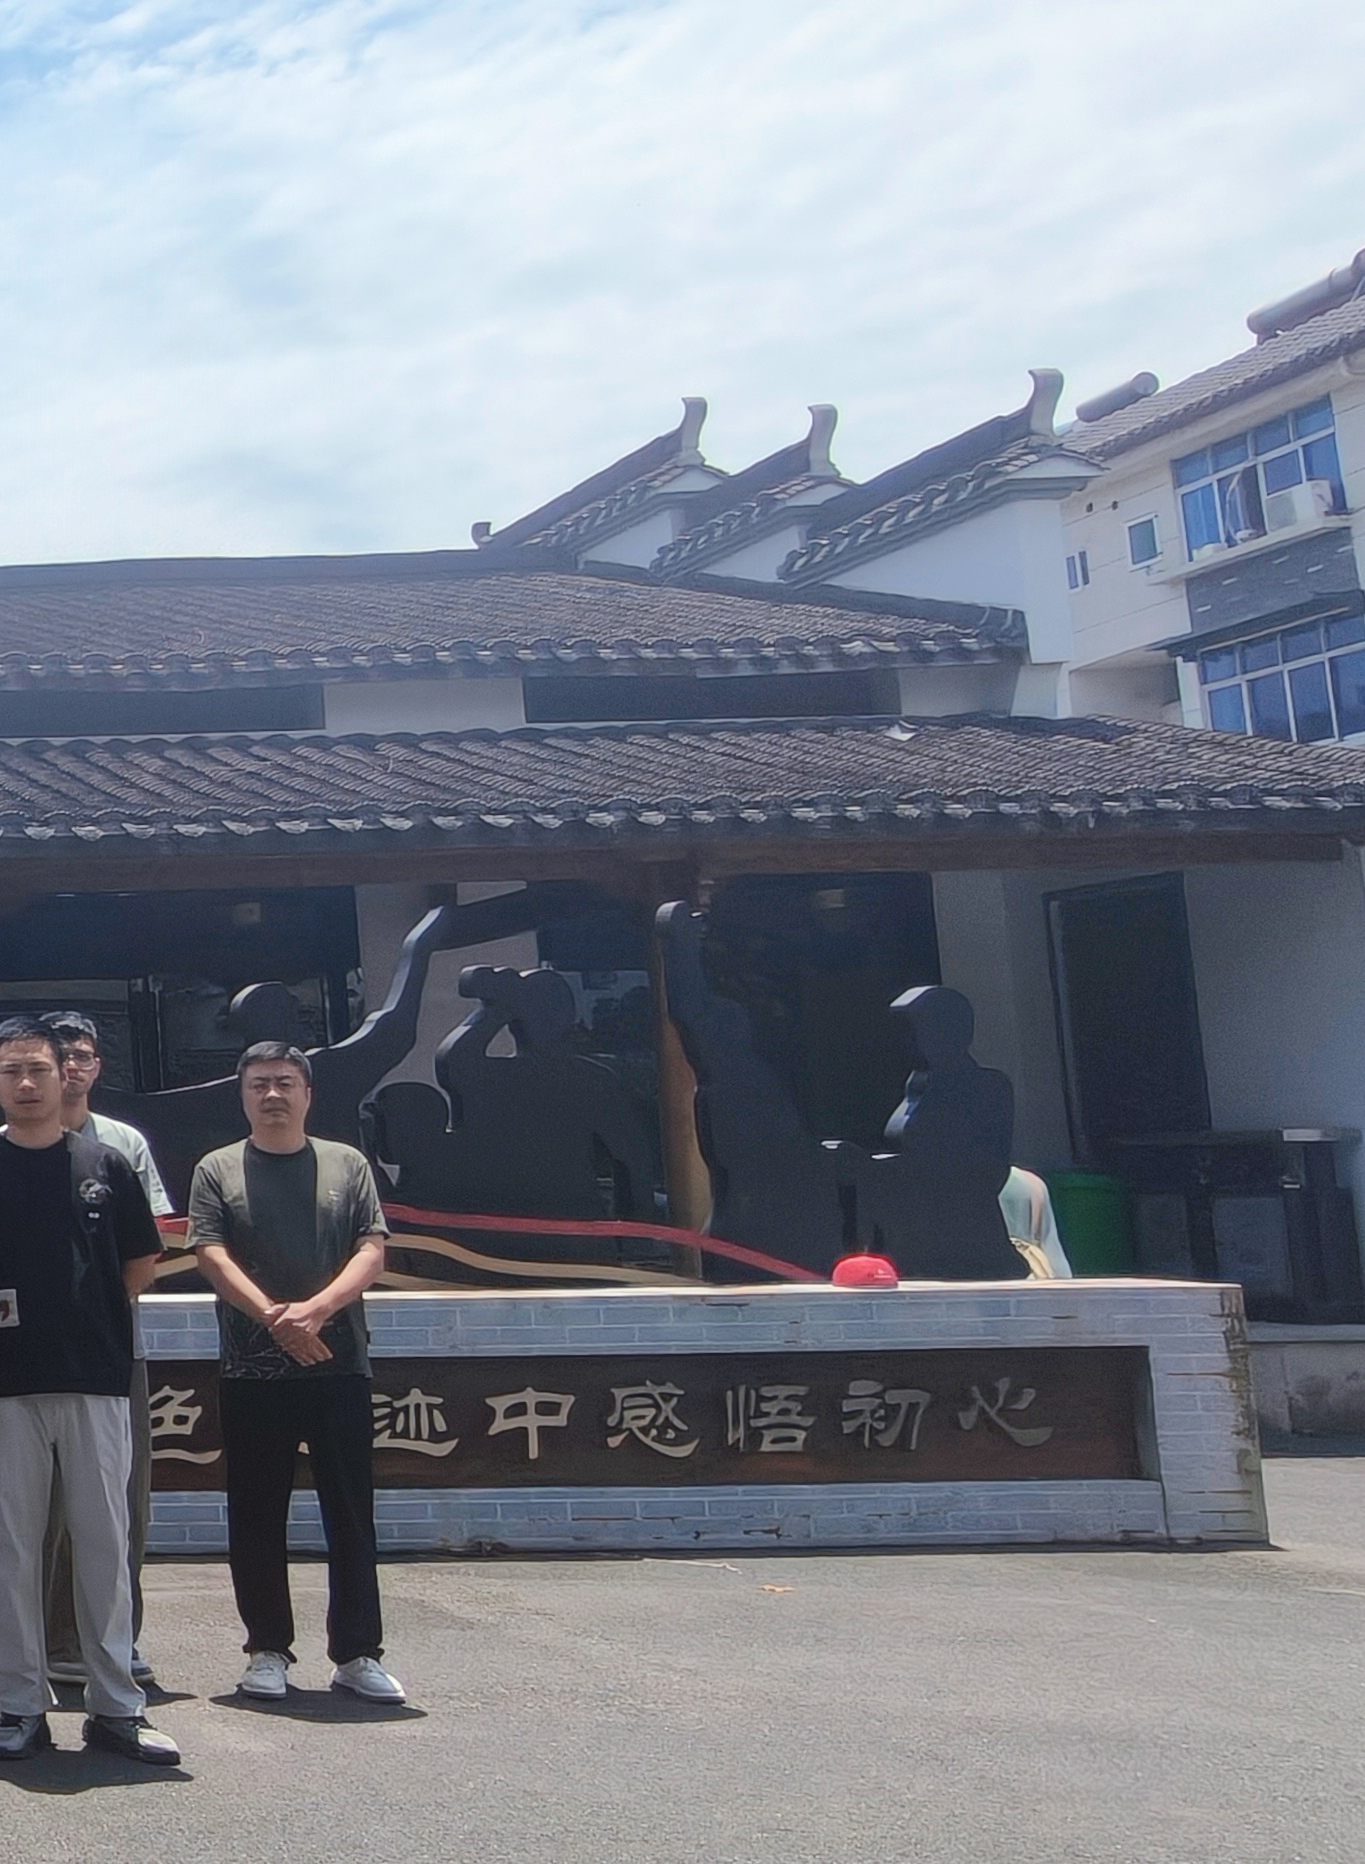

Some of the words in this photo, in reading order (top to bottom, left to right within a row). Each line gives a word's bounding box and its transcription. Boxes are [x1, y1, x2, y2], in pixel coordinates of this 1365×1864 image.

[148, 1377, 1054, 1464] 色迹中感悟初心
